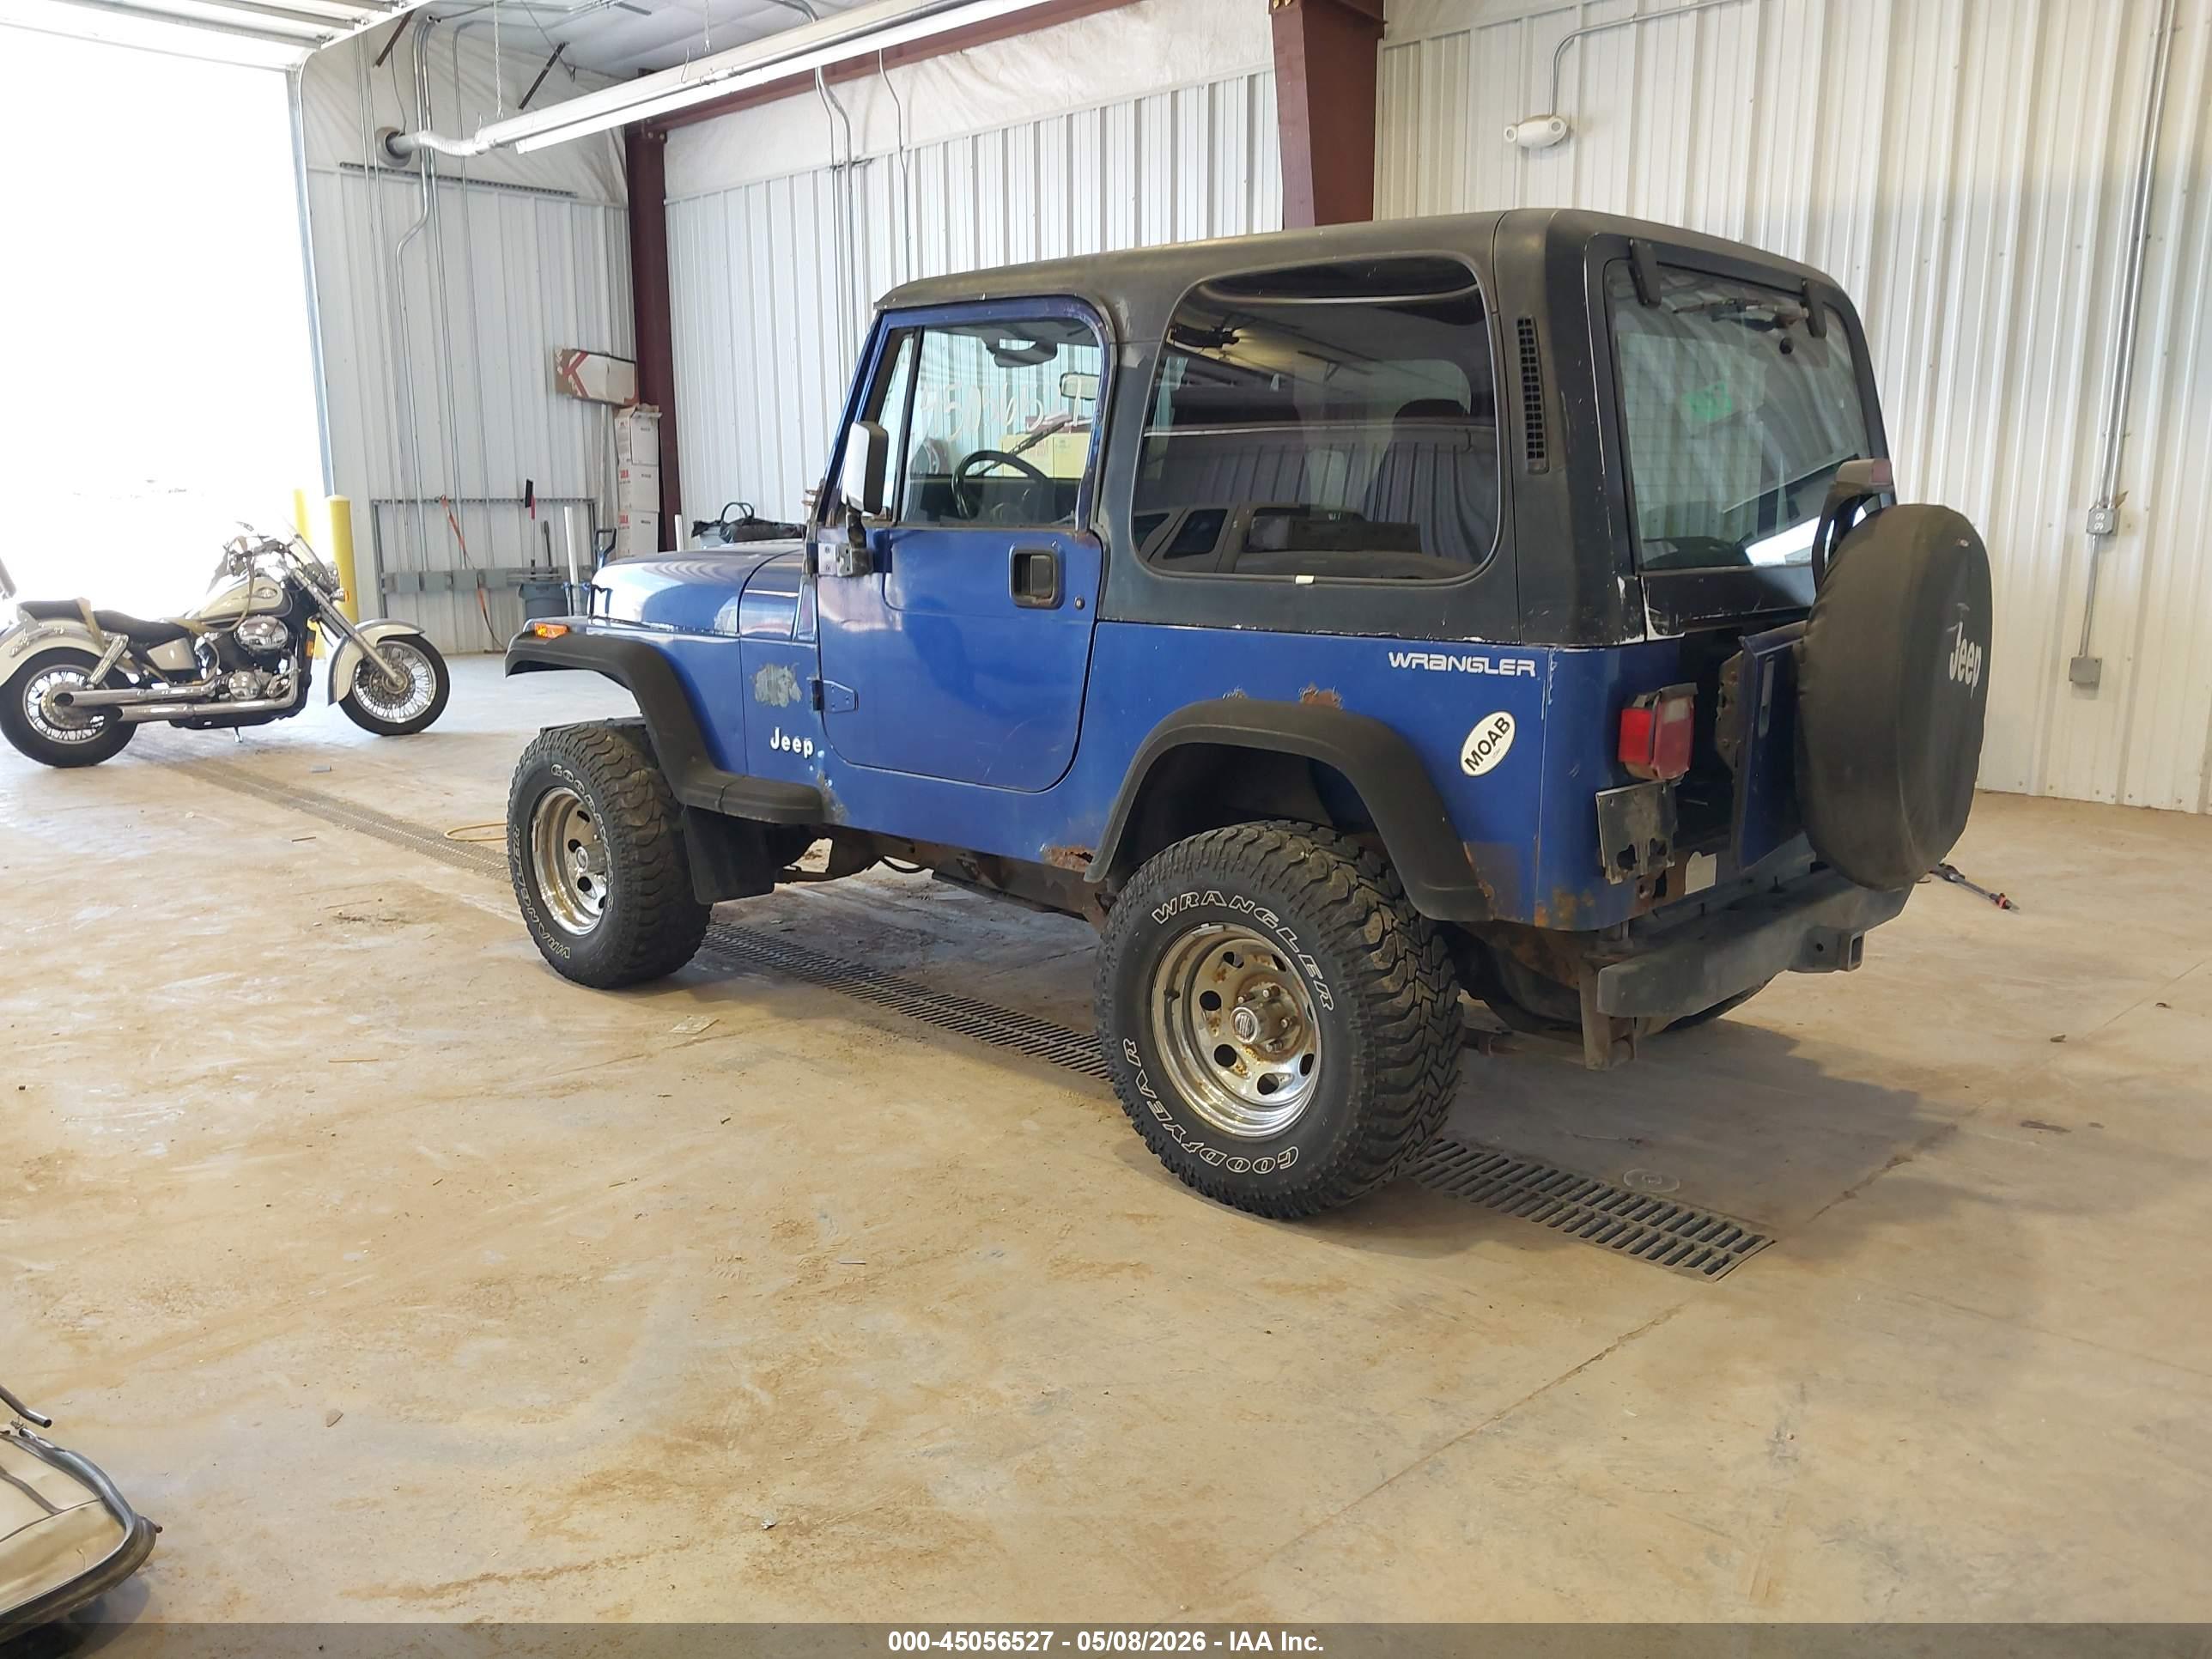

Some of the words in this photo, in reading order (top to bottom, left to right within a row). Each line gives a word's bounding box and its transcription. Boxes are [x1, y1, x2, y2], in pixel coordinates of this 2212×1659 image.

[1949, 621, 1982, 699] Jeep
[769, 726, 814, 759] Jeep
[1464, 716, 1511, 772] MOAB
[1151, 890, 1334, 1012] WRANGLER
[1122, 1038, 1300, 1174] GOODYEAR
